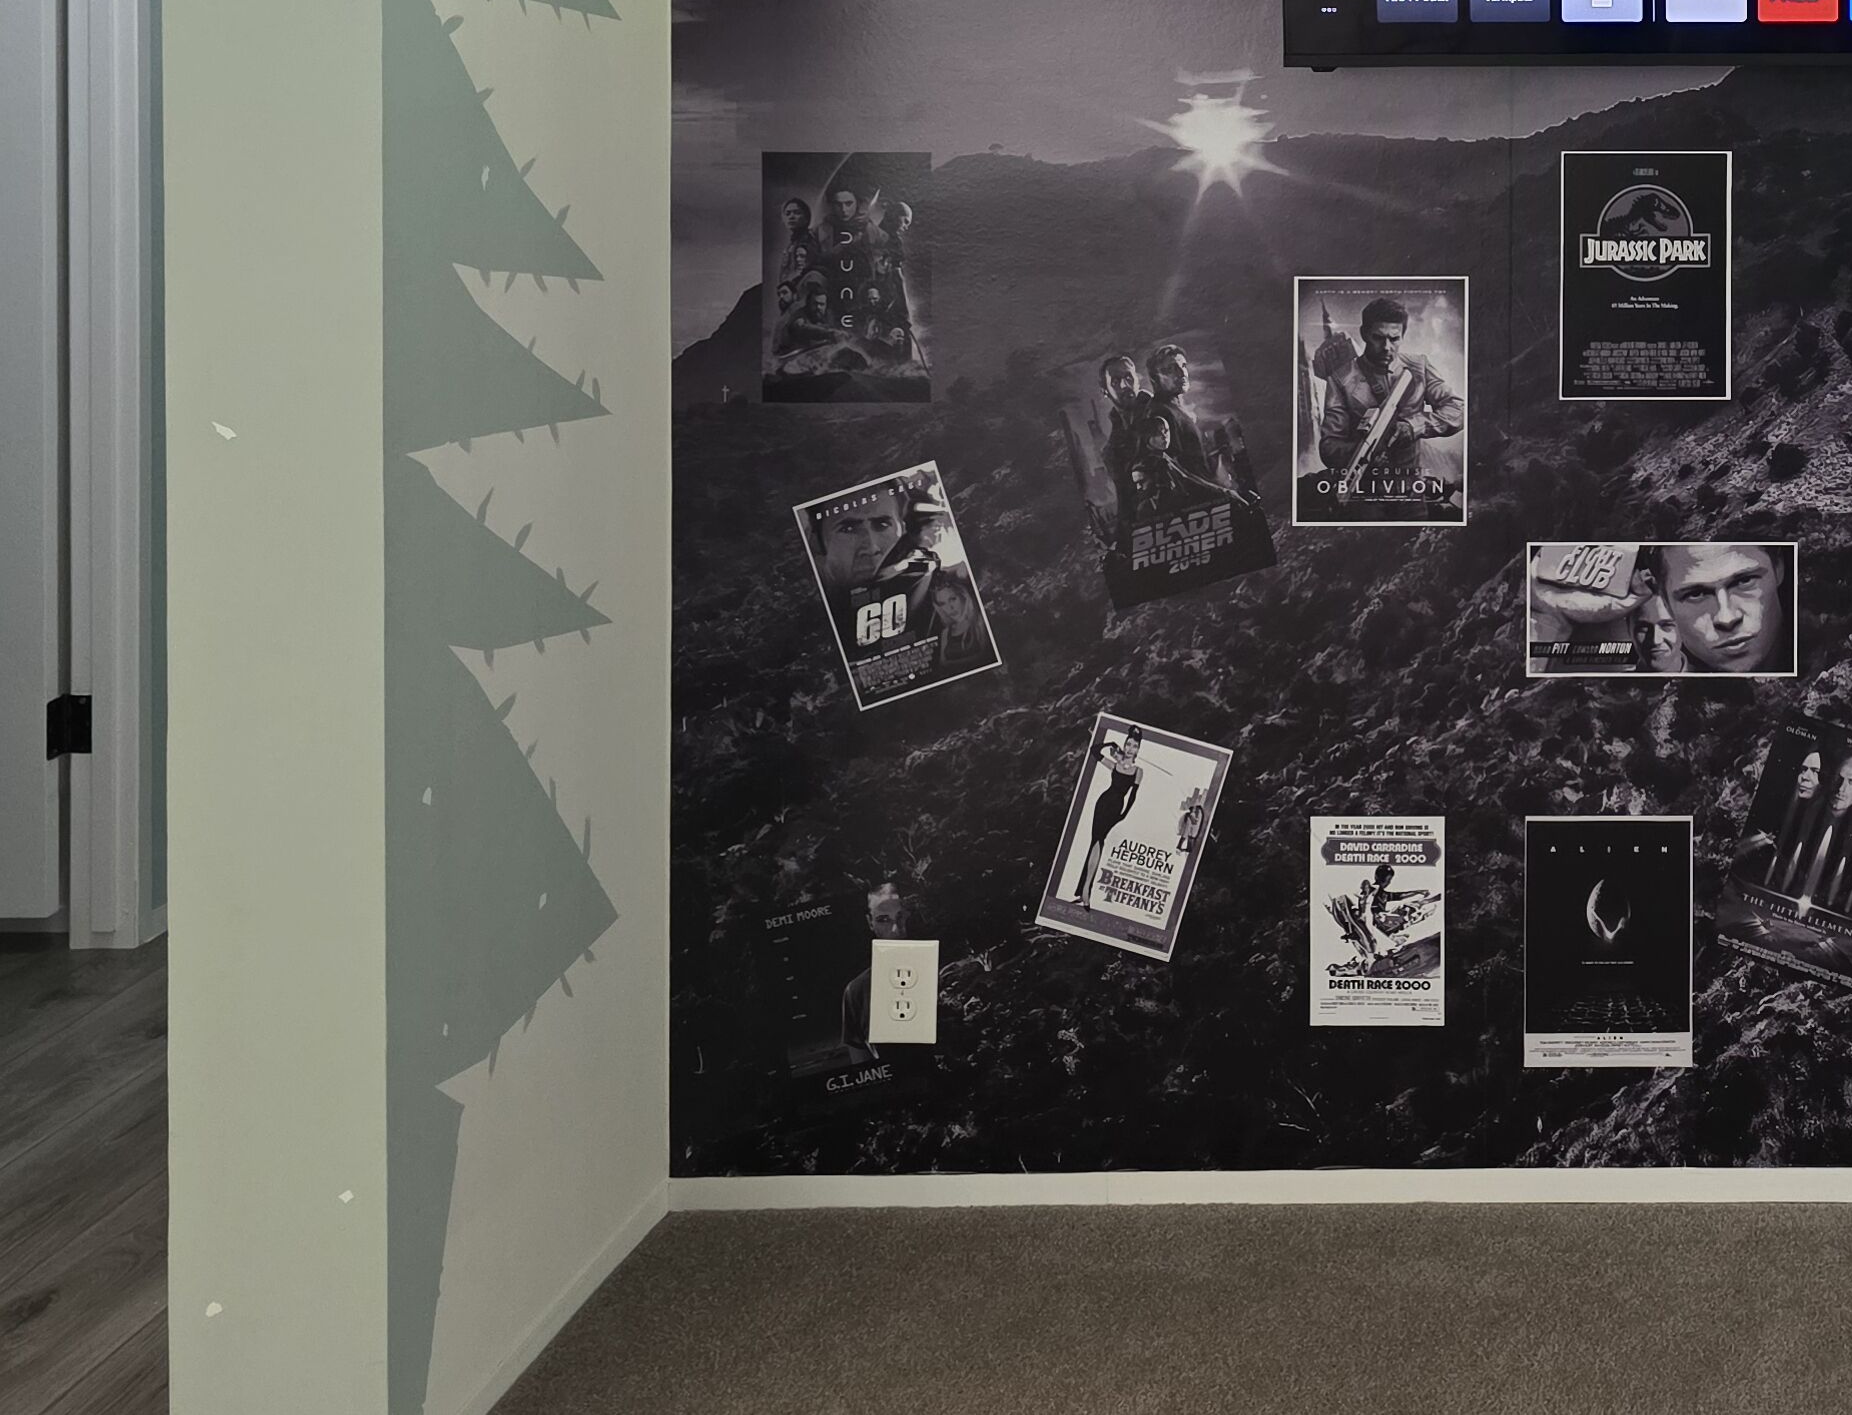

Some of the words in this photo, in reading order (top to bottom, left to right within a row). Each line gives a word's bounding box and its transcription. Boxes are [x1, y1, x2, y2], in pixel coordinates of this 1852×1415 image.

[1584, 238, 1657, 264] JURASSIC
[1659, 238, 1706, 264] PARK
[1317, 480, 1444, 494] OBLIVION
[1131, 503, 1231, 552] BLADE
[1131, 527, 1234, 571] RUNNER
[1557, 553, 1615, 589] CLUB
[856, 594, 907, 647] 60
[1552, 643, 1570, 654] PITT
[1599, 643, 1632, 654] NORTON
[1119, 839, 1172, 862] AUDREY
[1335, 853, 1365, 862] DEATH
[1367, 854, 1389, 862] RACE
[1395, 854, 1426, 863] 2000
[1340, 843, 1370, 852] DAVID
[1371, 843, 1423, 852] CARRADINE
[1111, 847, 1174, 874] HEPBURN
[1097, 868, 1171, 902] BREAKFAST
[1104, 886, 1165, 914] TIFFANY'S
[1742, 893, 1764, 907] THE
[765, 915, 793, 929] DEMI
[797, 905, 832, 921] MOORE
[1329, 980, 1364, 989] DEATH
[1367, 980, 1392, 989] RACE
[1395, 980, 1431, 990] 2000
[855, 1064, 894, 1085] JANE
